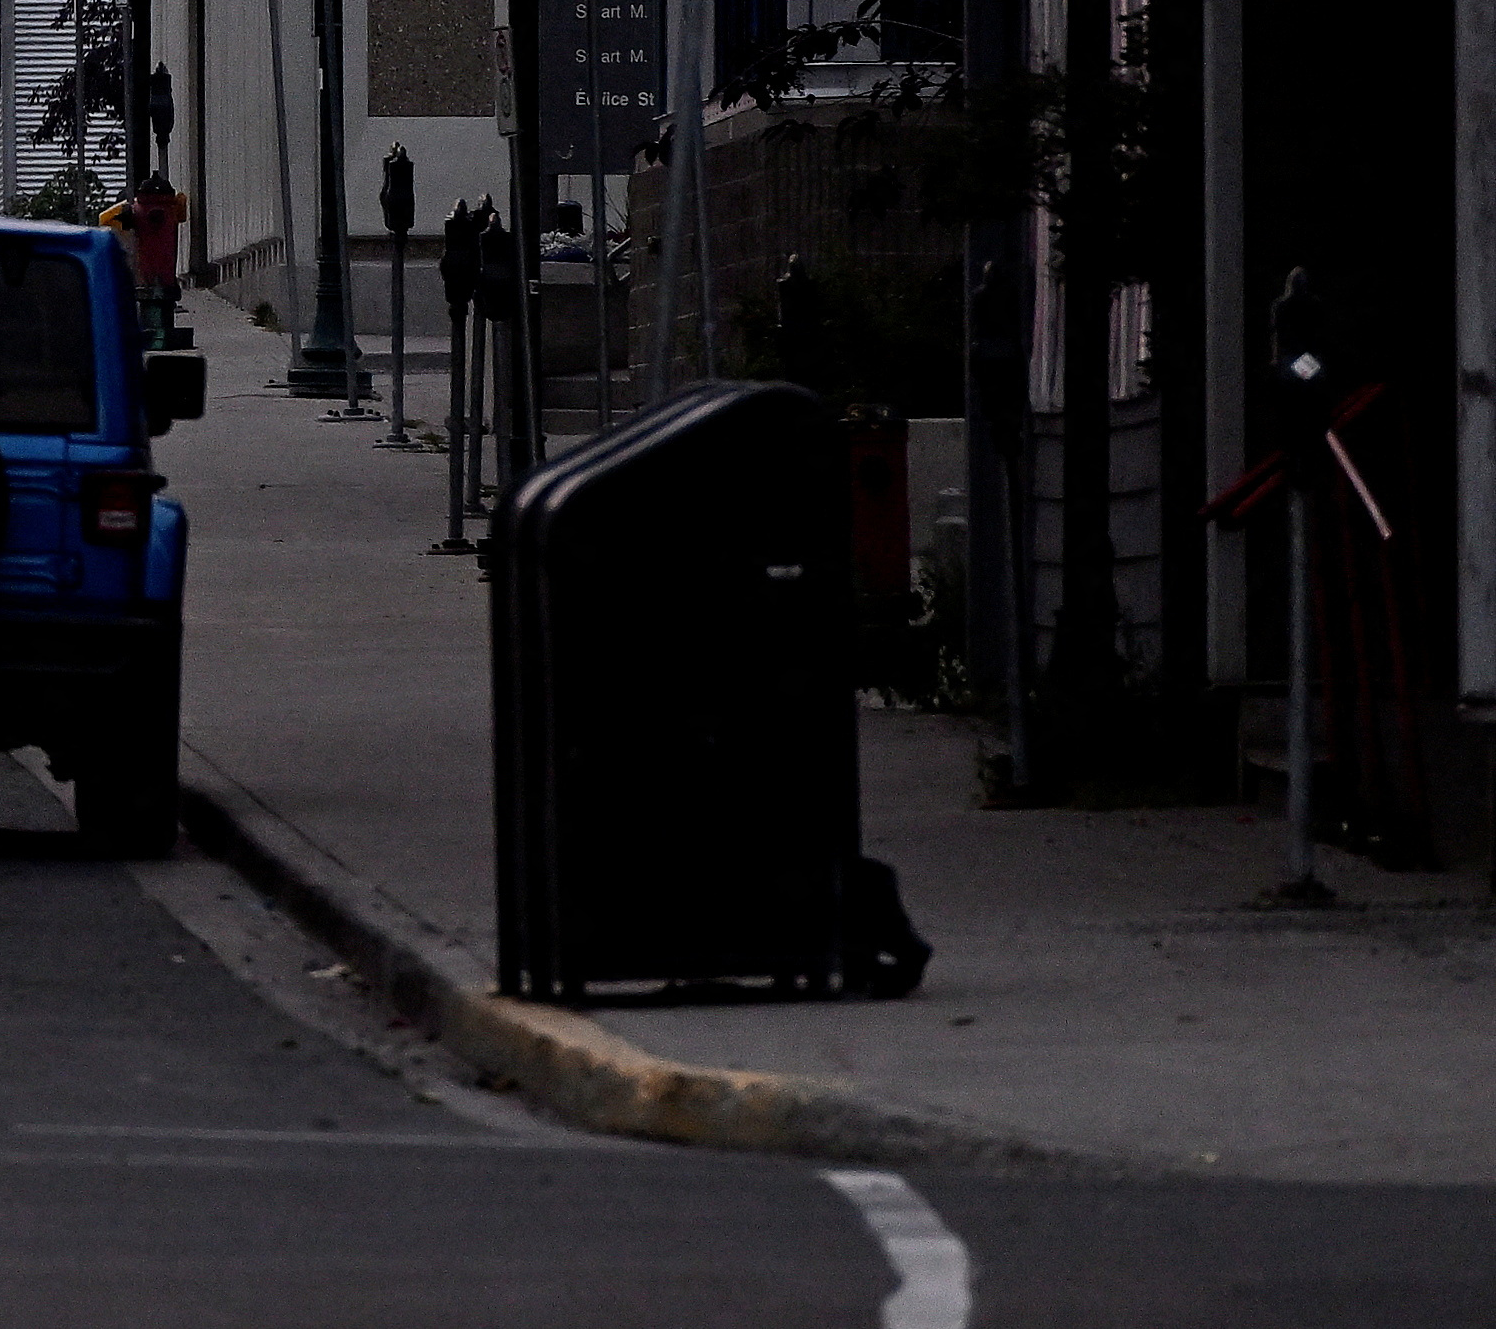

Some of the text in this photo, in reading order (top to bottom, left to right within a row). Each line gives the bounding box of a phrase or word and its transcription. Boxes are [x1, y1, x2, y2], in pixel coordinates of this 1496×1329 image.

[575, 3, 648, 19] Sart M.
[575, 48, 648, 63] Sart M.
